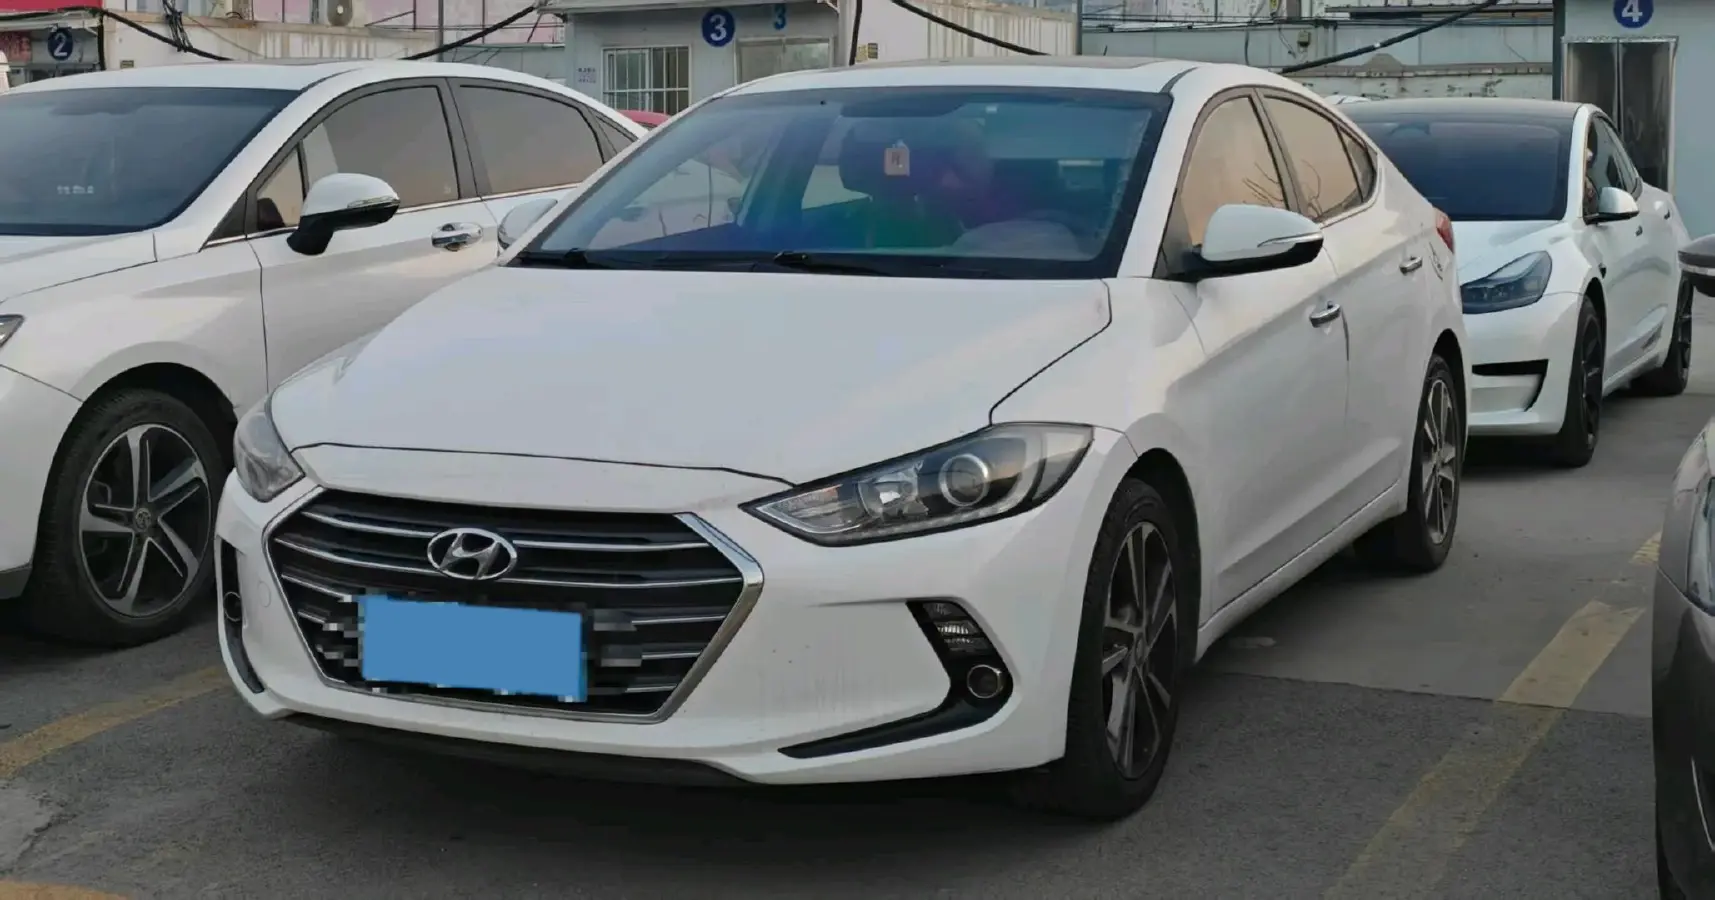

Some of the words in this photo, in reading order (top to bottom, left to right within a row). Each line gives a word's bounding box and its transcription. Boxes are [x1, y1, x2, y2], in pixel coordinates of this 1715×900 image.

[774, 3, 786, 30] 3
[1621, 0, 1643, 22] 4
[710, 14, 727, 41] 3
[54, 32, 68, 57] 2
